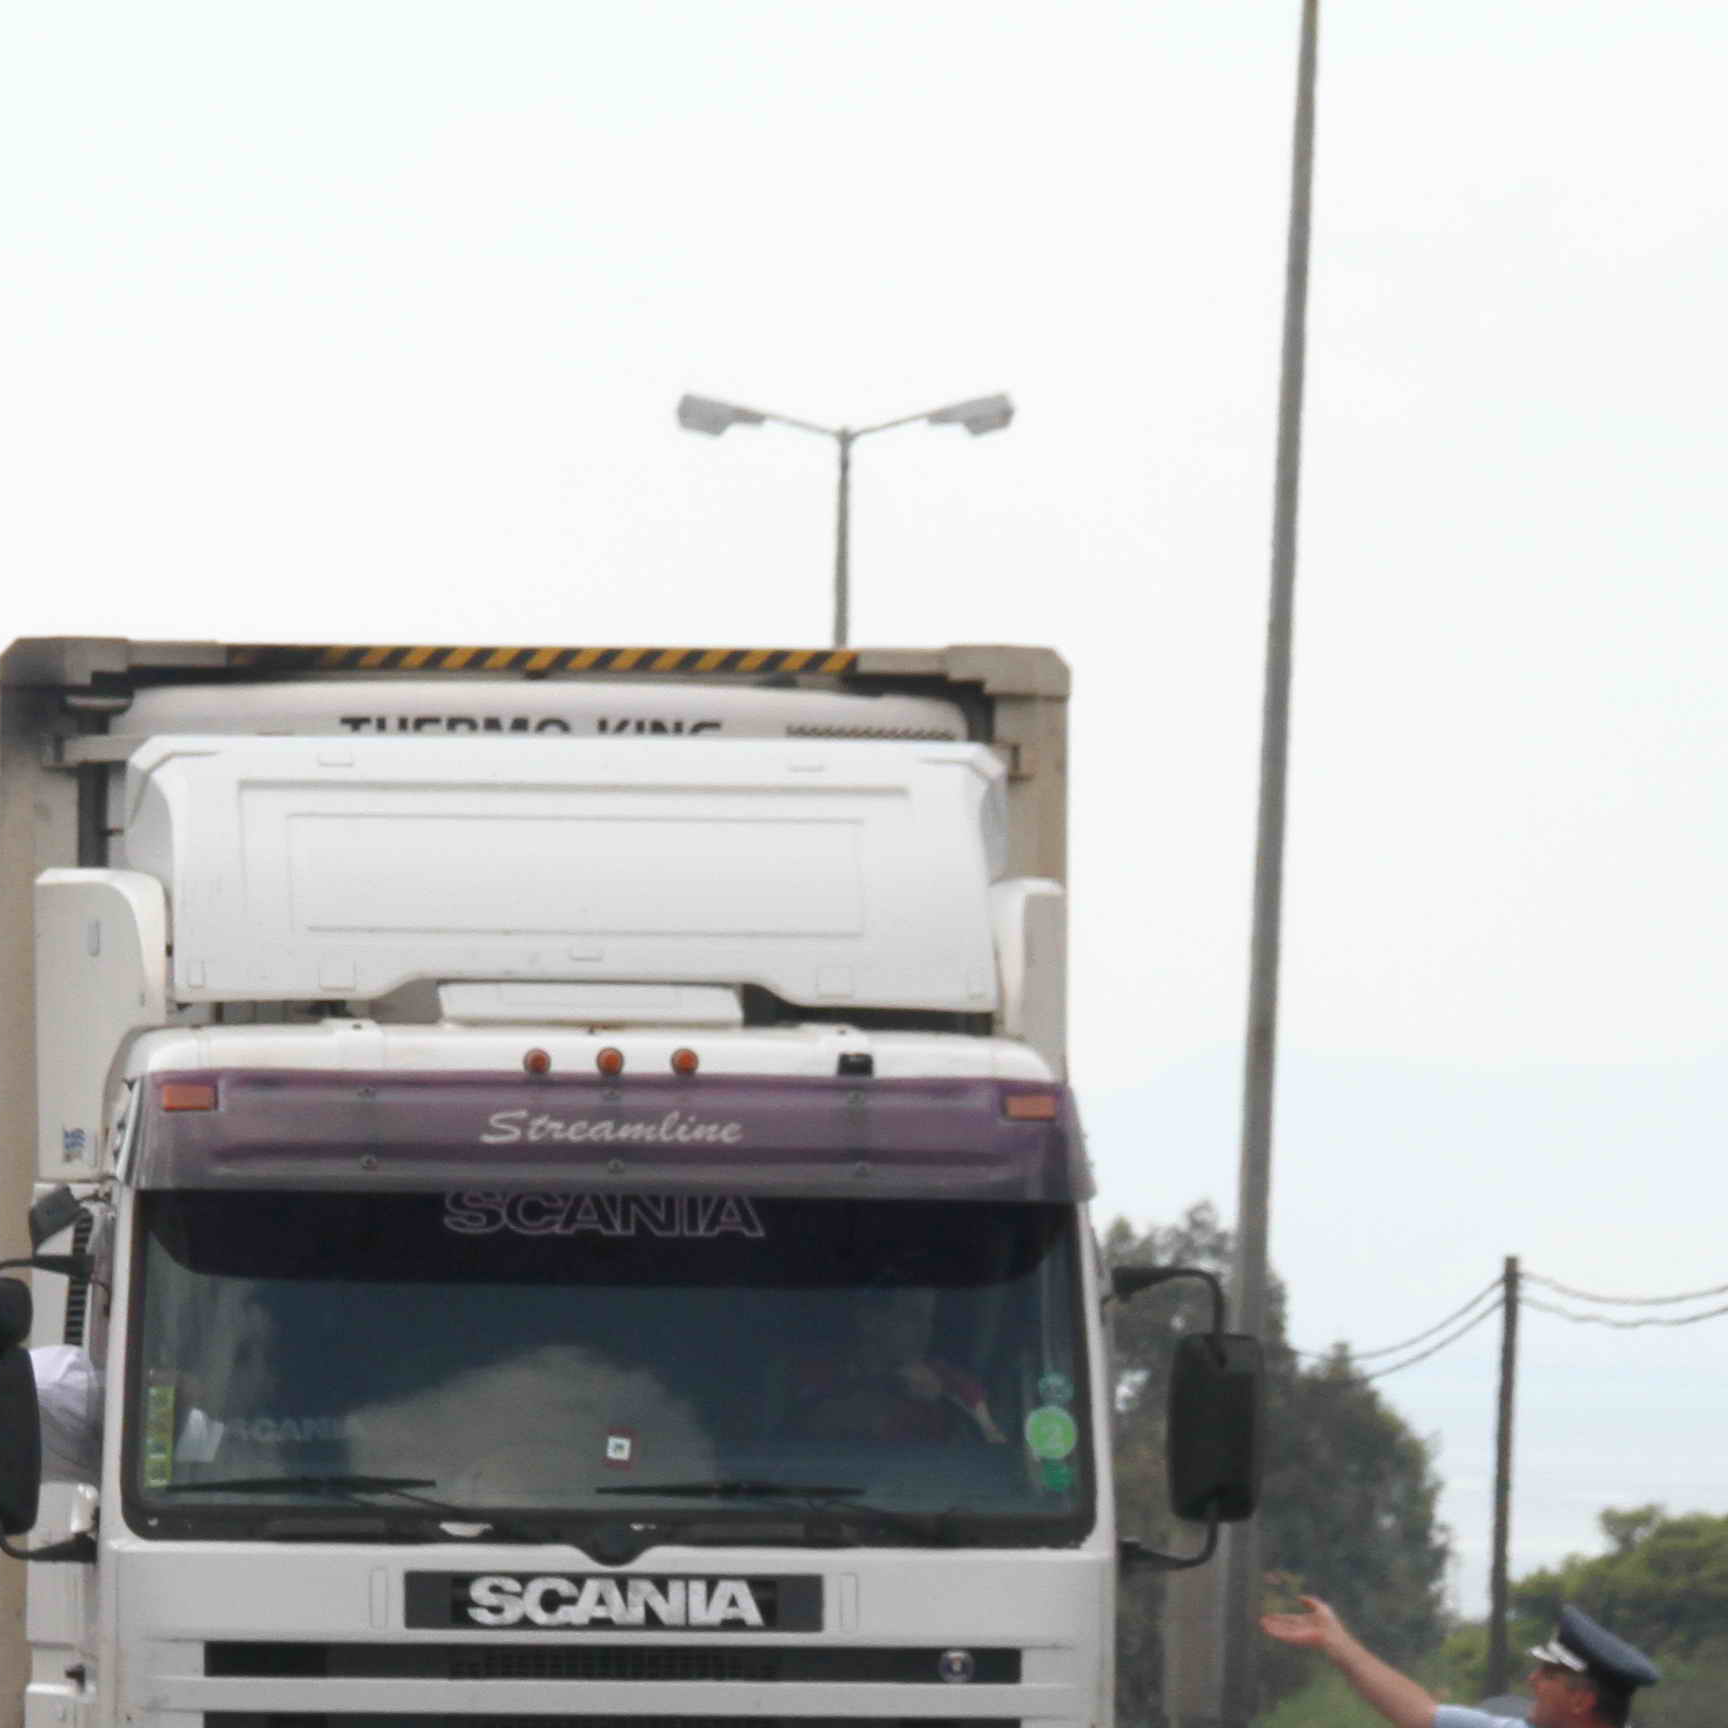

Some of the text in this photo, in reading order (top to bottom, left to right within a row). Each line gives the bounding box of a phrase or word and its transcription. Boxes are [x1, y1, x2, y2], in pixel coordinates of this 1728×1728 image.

[479, 1108, 744, 1145] Streamline
[442, 1189, 766, 1239] SCANIA
[467, 1575, 766, 1627] SCANIA
